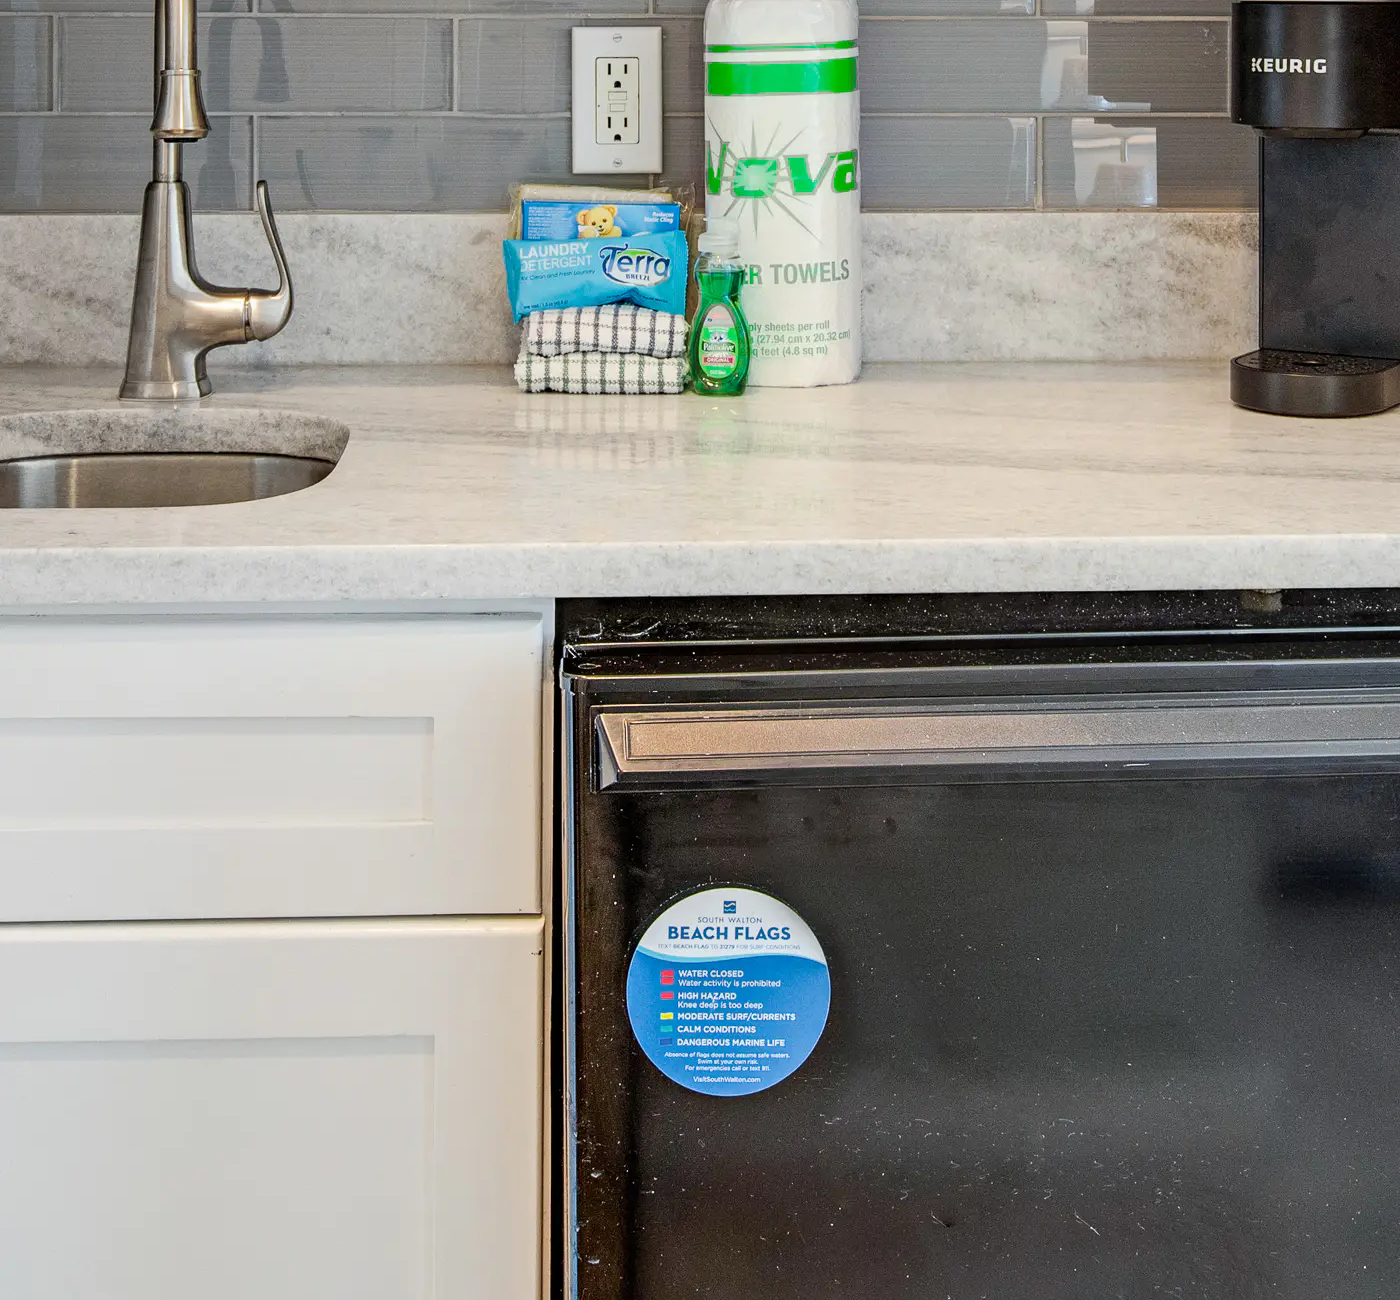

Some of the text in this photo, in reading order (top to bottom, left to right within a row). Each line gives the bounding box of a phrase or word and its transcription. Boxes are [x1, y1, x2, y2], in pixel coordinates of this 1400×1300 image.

[1252, 58, 1326, 73] KEURIG
[520, 242, 588, 258] LAUNDRY
[521, 255, 592, 272] DETERGENT
[600, 243, 670, 277] Terra
[770, 259, 849, 284] TOWELS
[765, 323, 795, 331] sheets
[798, 323, 813, 332] per
[815, 320, 830, 329] roll
[757, 334, 785, 345] (27.94
[788, 335, 802, 343] cm
[814, 332, 836, 341] 20.32
[839, 329, 850, 339] cm)
[704, 343, 734, 351] Palmolive
[761, 347, 779, 355] feet
[783, 347, 800, 357] (4.8
[803, 347, 813, 356] sq
[816, 345, 828, 355] m)
[668, 926, 791, 940] BEACH FLAGS
[679, 970, 744, 978] WATER CLOSED
[703, 979, 730, 988] activity
[741, 980, 781, 988] prohibited
[678, 992, 737, 1000] HIGH HAZARD
[699, 1002, 718, 1010] deep
[744, 1002, 763, 1010] deep
[726, 1013, 796, 1021] SURF/CURRENTS
[678, 1025, 756, 1033] CALM CONDITIONS
